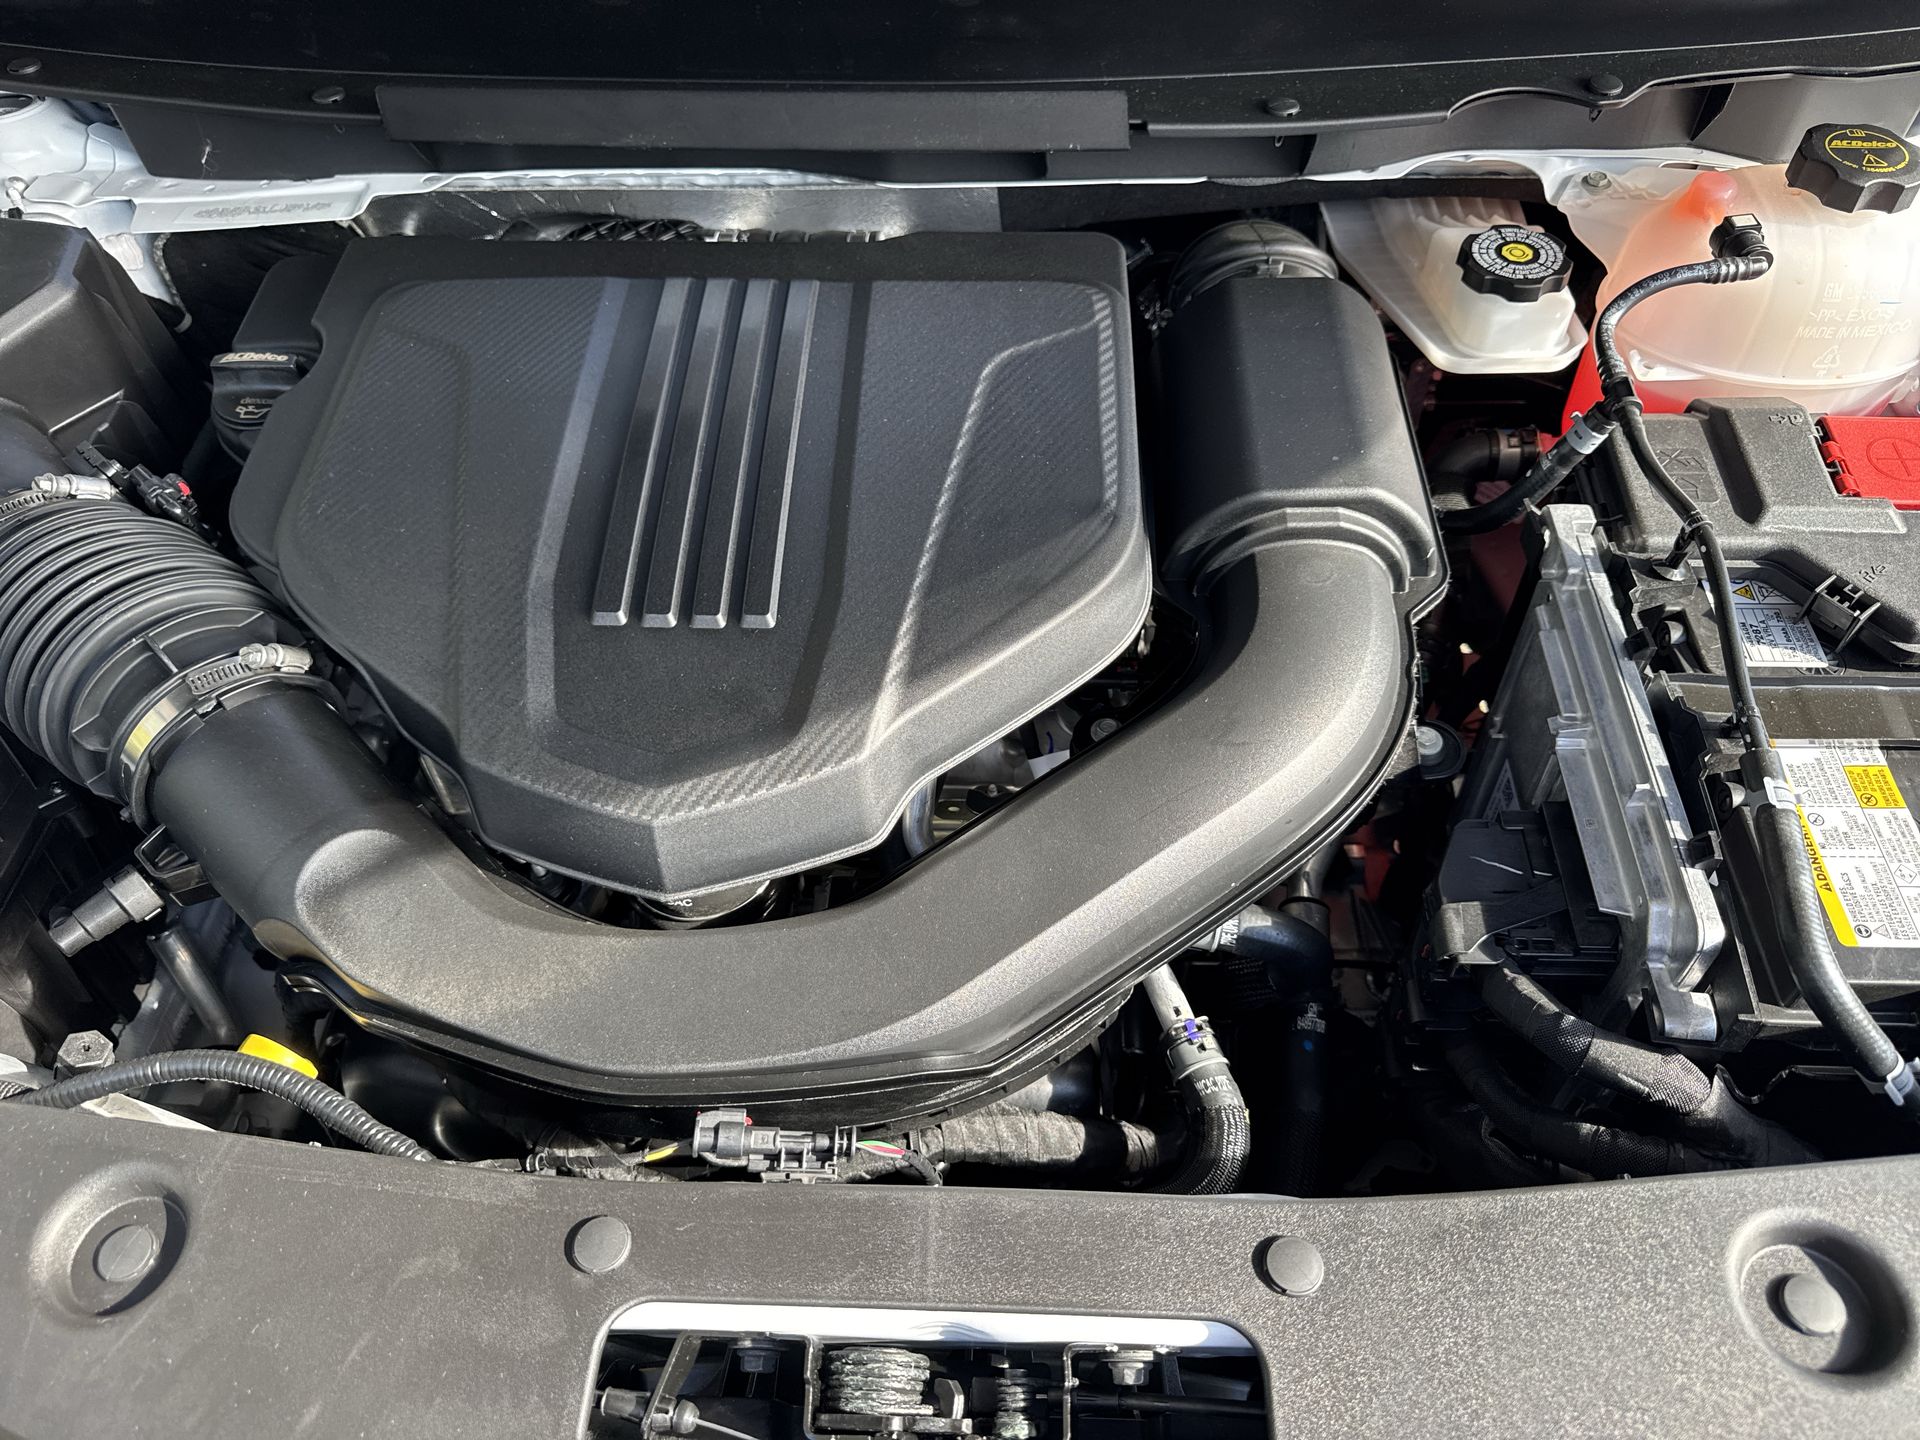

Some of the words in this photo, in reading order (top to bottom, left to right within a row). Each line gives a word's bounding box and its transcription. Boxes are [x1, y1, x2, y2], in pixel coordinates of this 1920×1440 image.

[1829, 139, 1898, 149] ACDelco
[1796, 325, 1836, 339] MADE
[219, 351, 289, 363] ACDelco
